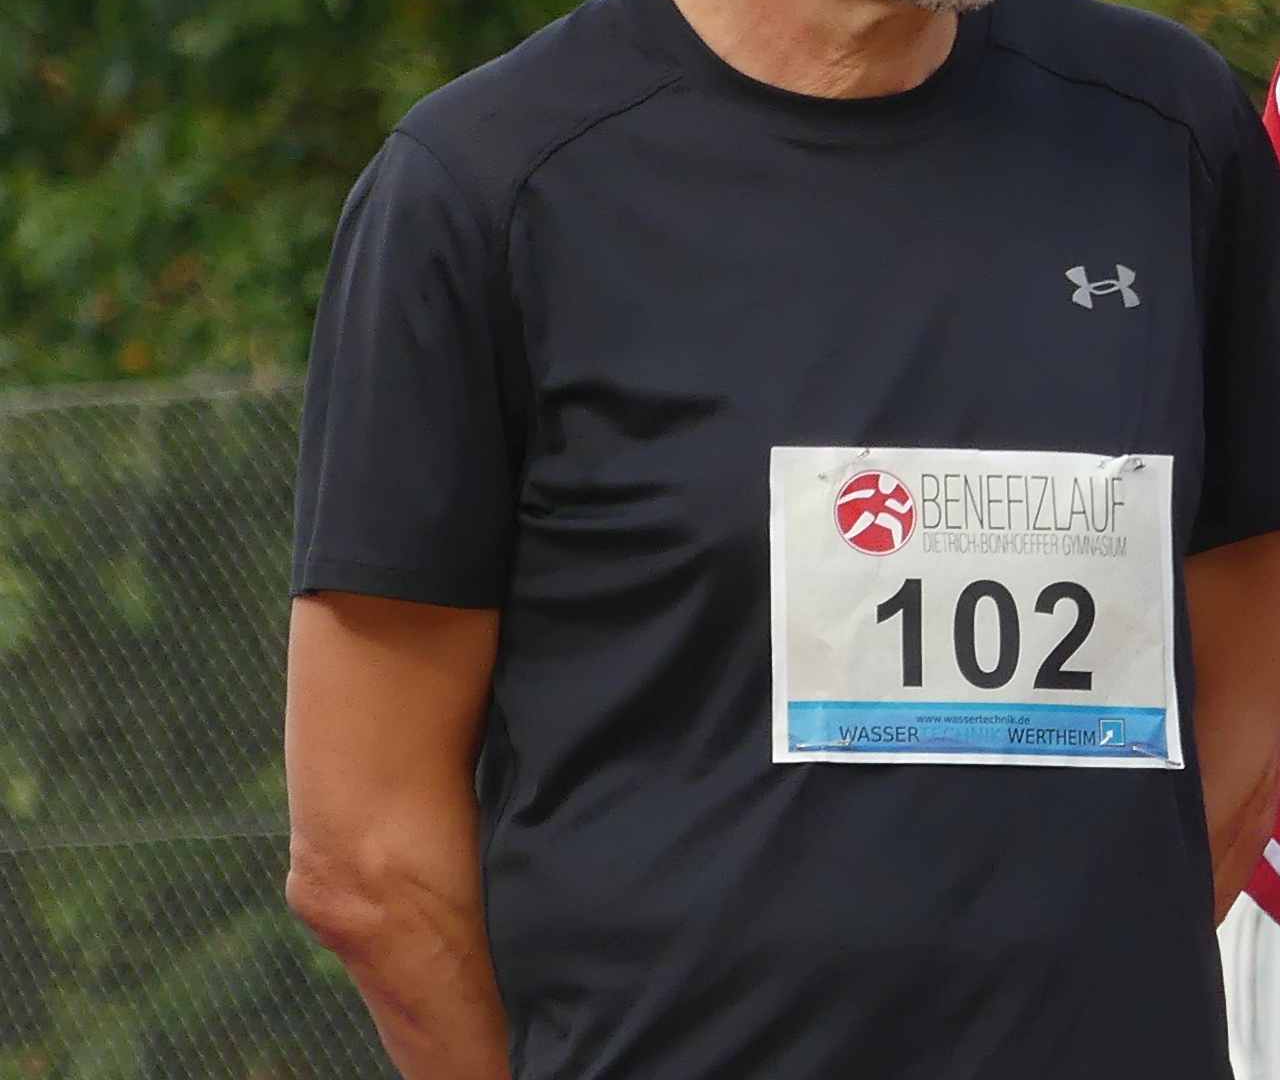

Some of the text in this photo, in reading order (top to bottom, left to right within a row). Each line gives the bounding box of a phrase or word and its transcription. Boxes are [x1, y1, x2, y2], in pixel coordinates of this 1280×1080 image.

[920, 473, 1126, 533] BENEFIZLAUF
[1062, 535, 1128, 557] GYMNASIUM
[876, 578, 1096, 690] 102
[915, 714, 1031, 726] www.wassertechnik.de
[1007, 727, 1096, 746] WERTHEIM
